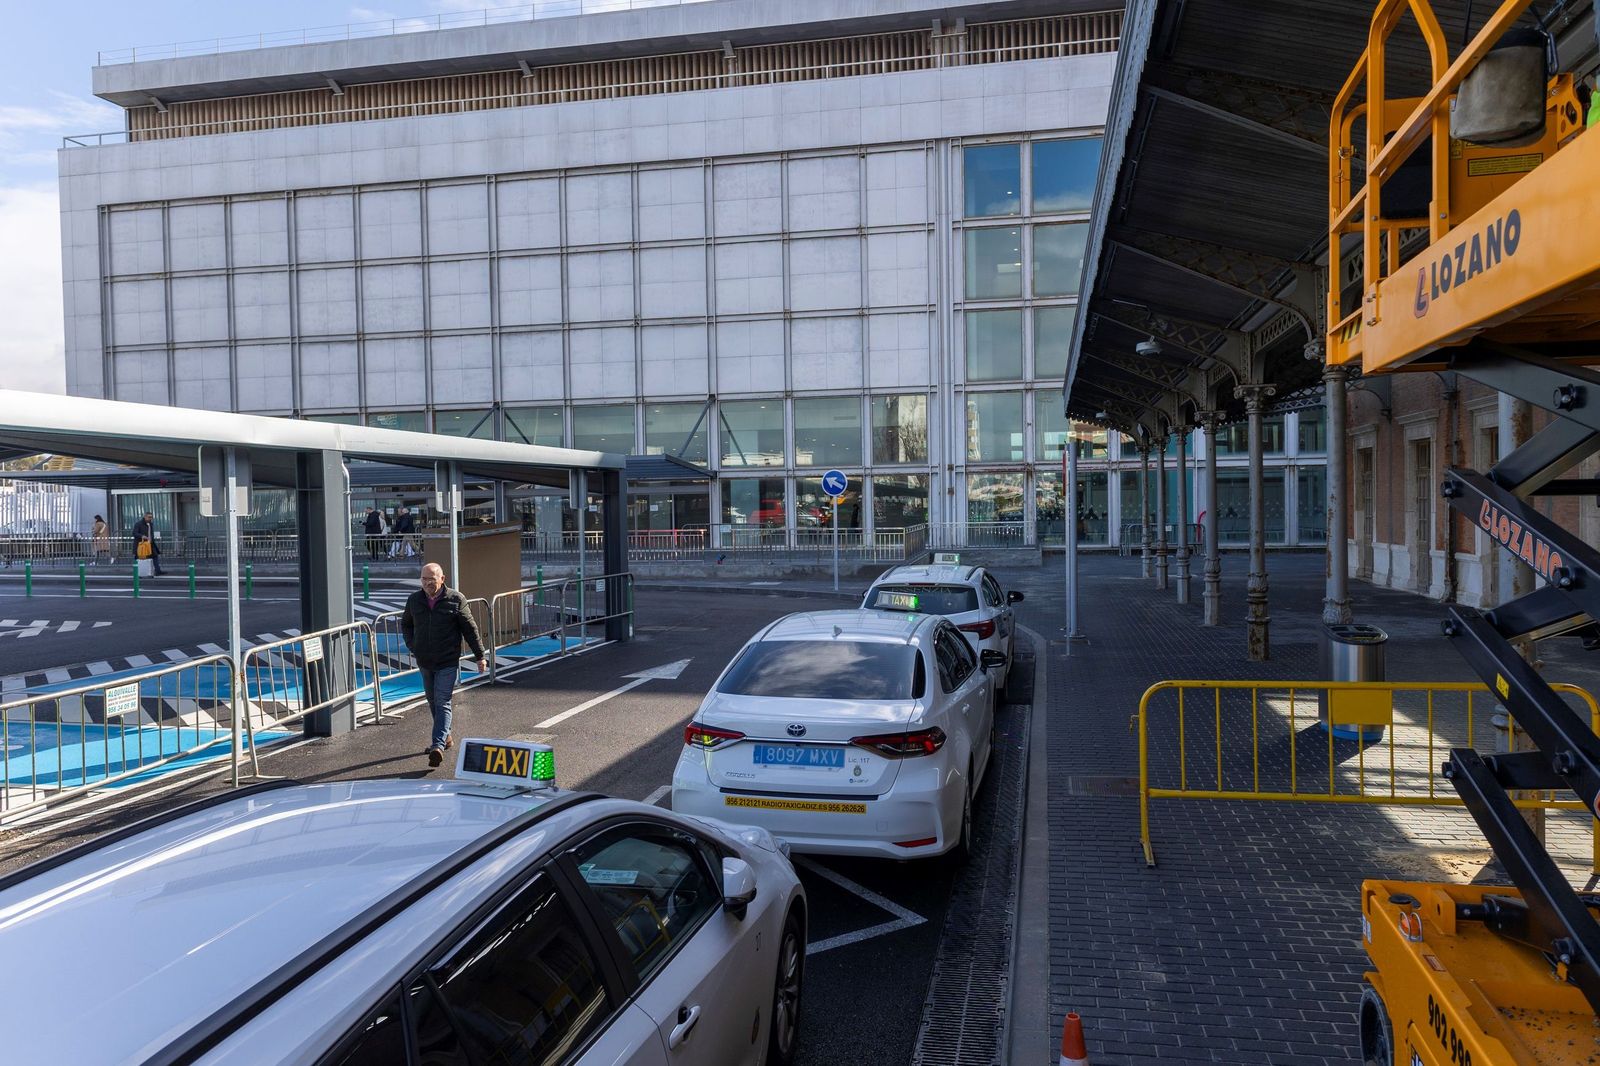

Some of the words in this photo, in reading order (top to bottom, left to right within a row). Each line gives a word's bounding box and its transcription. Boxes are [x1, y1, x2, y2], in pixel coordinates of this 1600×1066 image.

[1431, 208, 1521, 301] LOZANO
[1491, 507, 1562, 581] LOZANO
[891, 594, 909, 606] TAXI
[483, 746, 530, 776] TAXI
[766, 748, 805, 763] 8097
[809, 749, 839, 764] MXV
[726, 797, 737, 806] 956
[739, 798, 760, 807] 212121
[762, 800, 827, 810] RADIOTAXICADIZ.ES
[828, 803, 840, 812] 956
[842, 804, 864, 813] 262626
[1428, 993, 1448, 1051] 902
